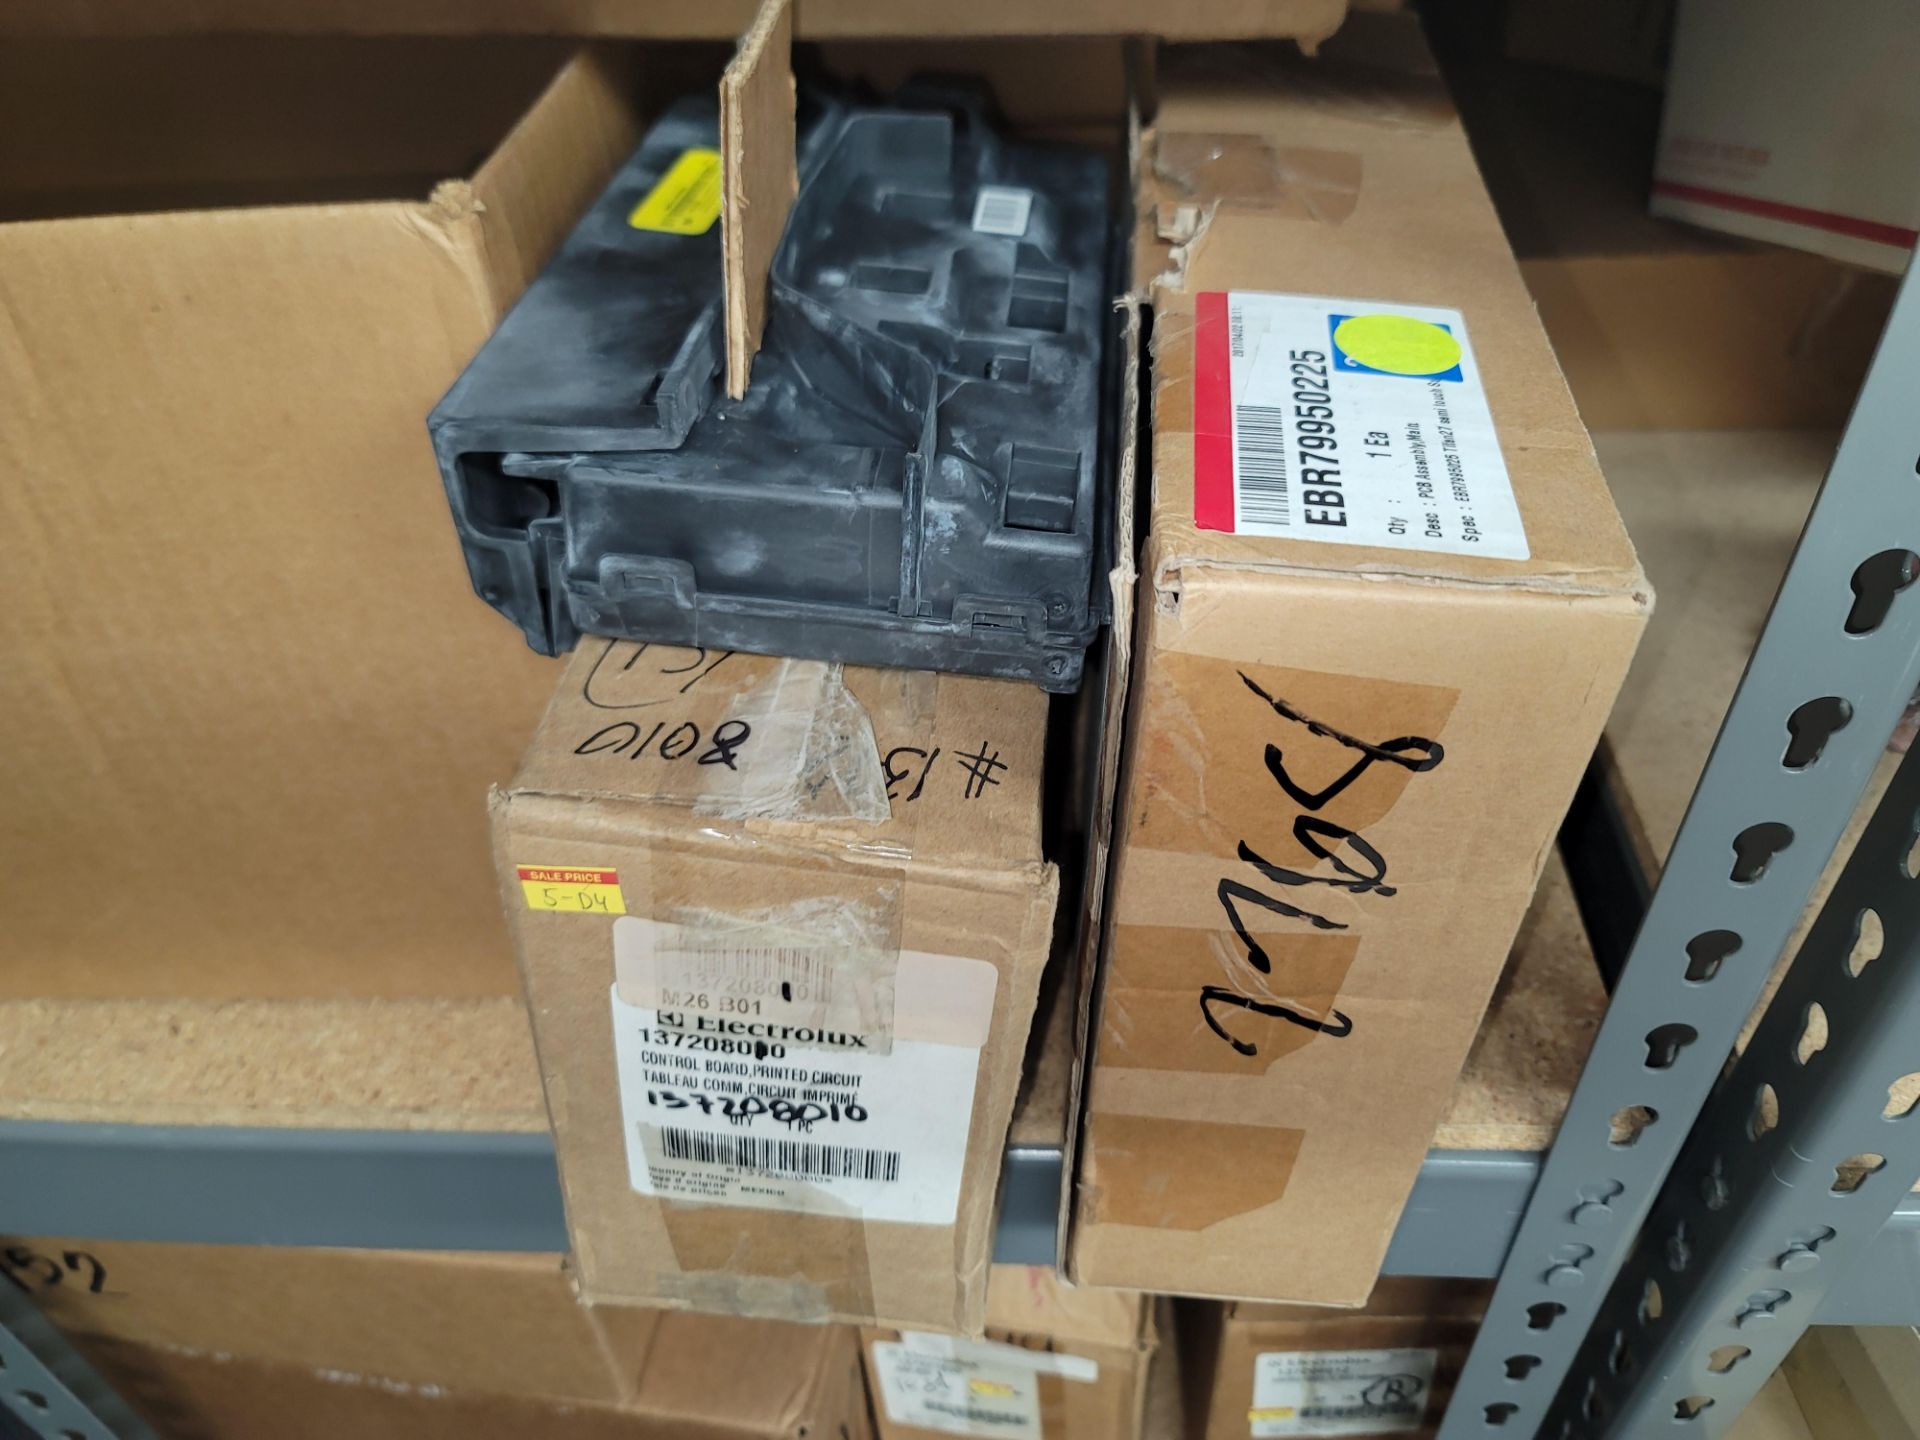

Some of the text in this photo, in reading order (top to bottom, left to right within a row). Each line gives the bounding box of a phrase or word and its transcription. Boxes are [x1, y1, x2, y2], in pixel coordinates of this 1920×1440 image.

[1289, 349, 1348, 527] EBR79950225
[1364, 431, 1390, 447] Ea
[1416, 481, 1435, 499] PCB
[1388, 516, 1408, 535] Qty
[1425, 513, 1443, 538] Desc
[1461, 515, 1482, 543] Spec
[530, 871, 602, 883] SALE PRICE
[698, 1016, 868, 1048] Electrolux
[641, 1050, 700, 1071] CONTROL
[812, 1070, 863, 1087] CIRCUIT
[642, 1069, 698, 1089] TABLEAU
